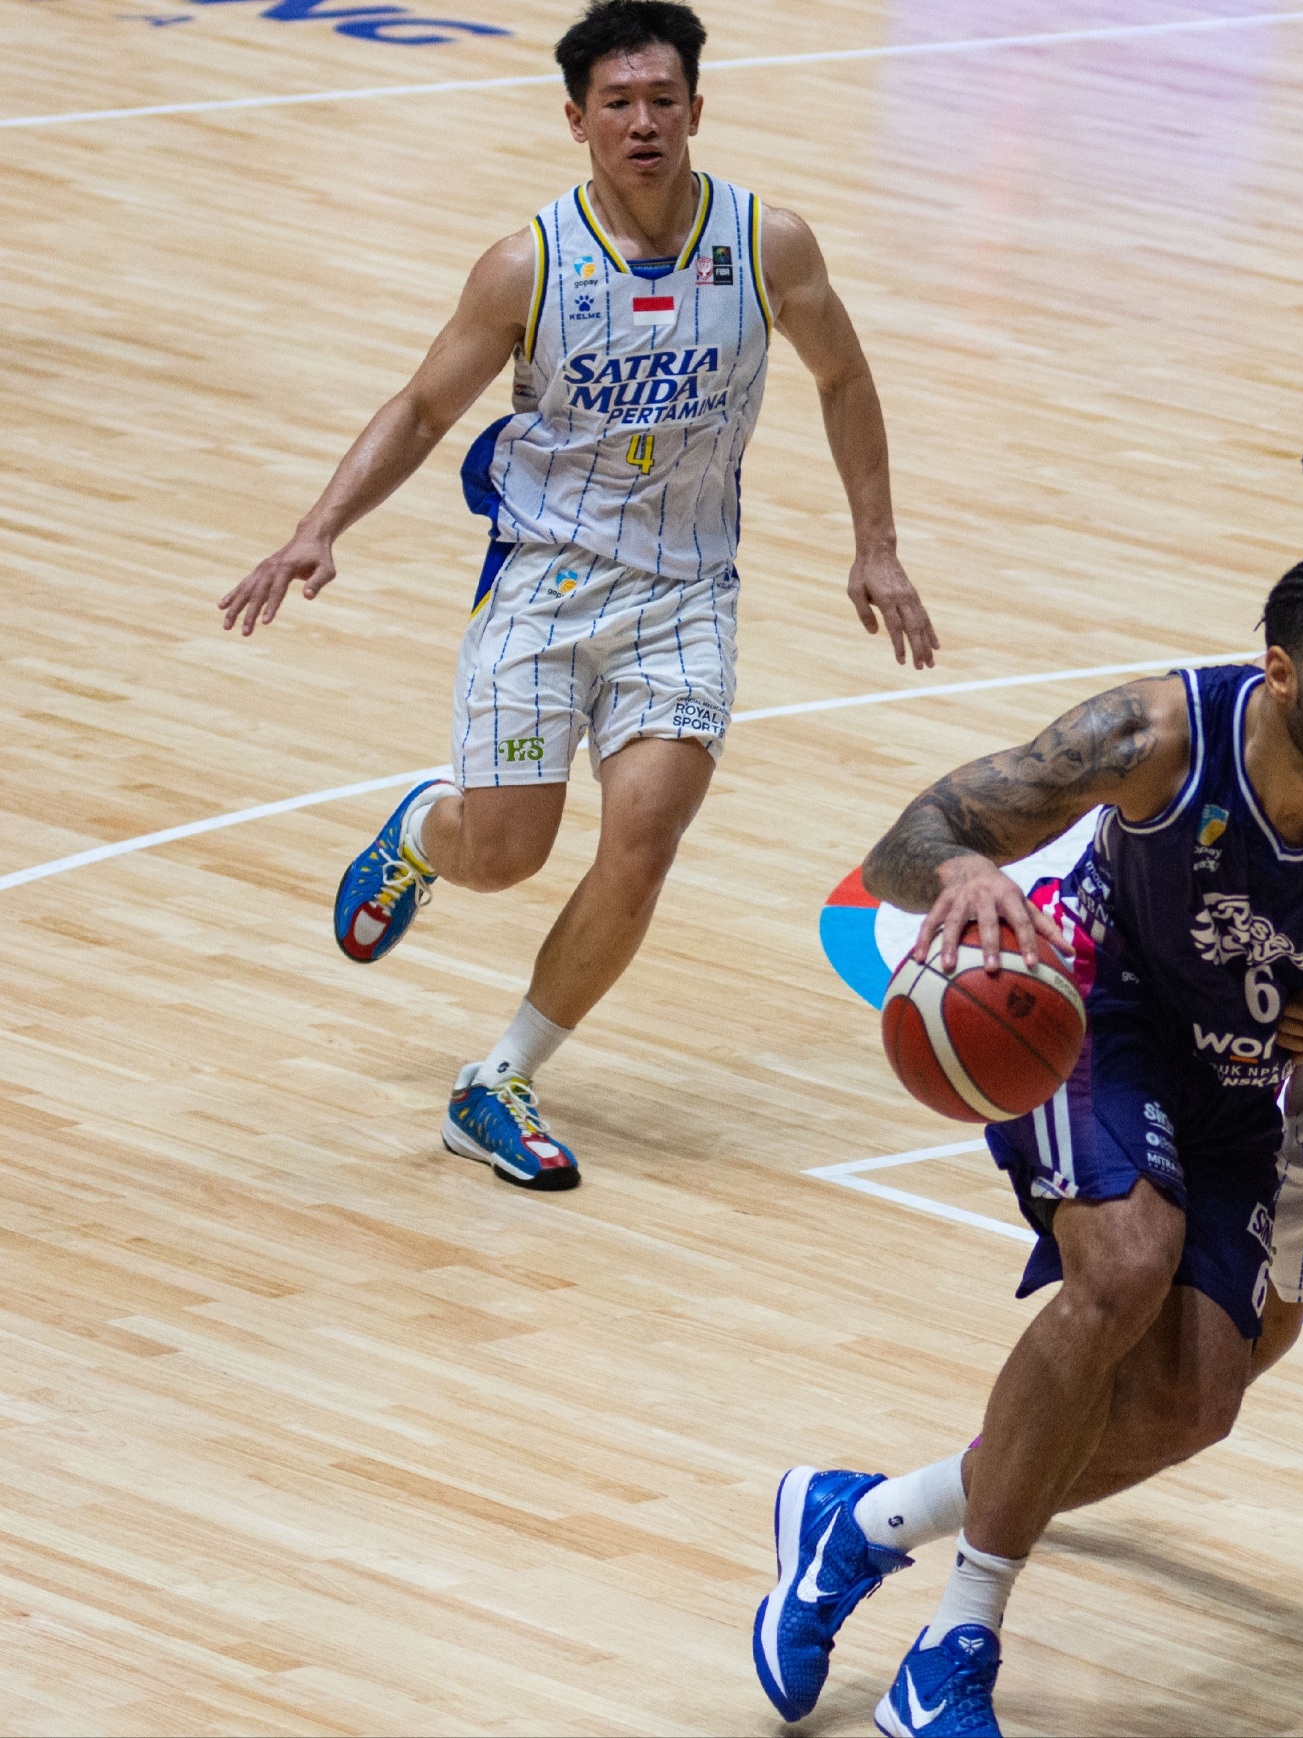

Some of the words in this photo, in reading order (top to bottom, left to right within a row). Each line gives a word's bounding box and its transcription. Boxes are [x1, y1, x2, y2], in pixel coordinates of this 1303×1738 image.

[574, 279, 598, 289] gopay
[569, 312, 602, 320] KELME
[563, 348, 718, 384] SATRIA
[569, 375, 699, 413] MUDA
[606, 391, 727, 424] PERTAMINA
[626, 433, 655, 475] 4
[675, 703, 718, 724] ROYAL
[1244, 965, 1281, 1023] 6
